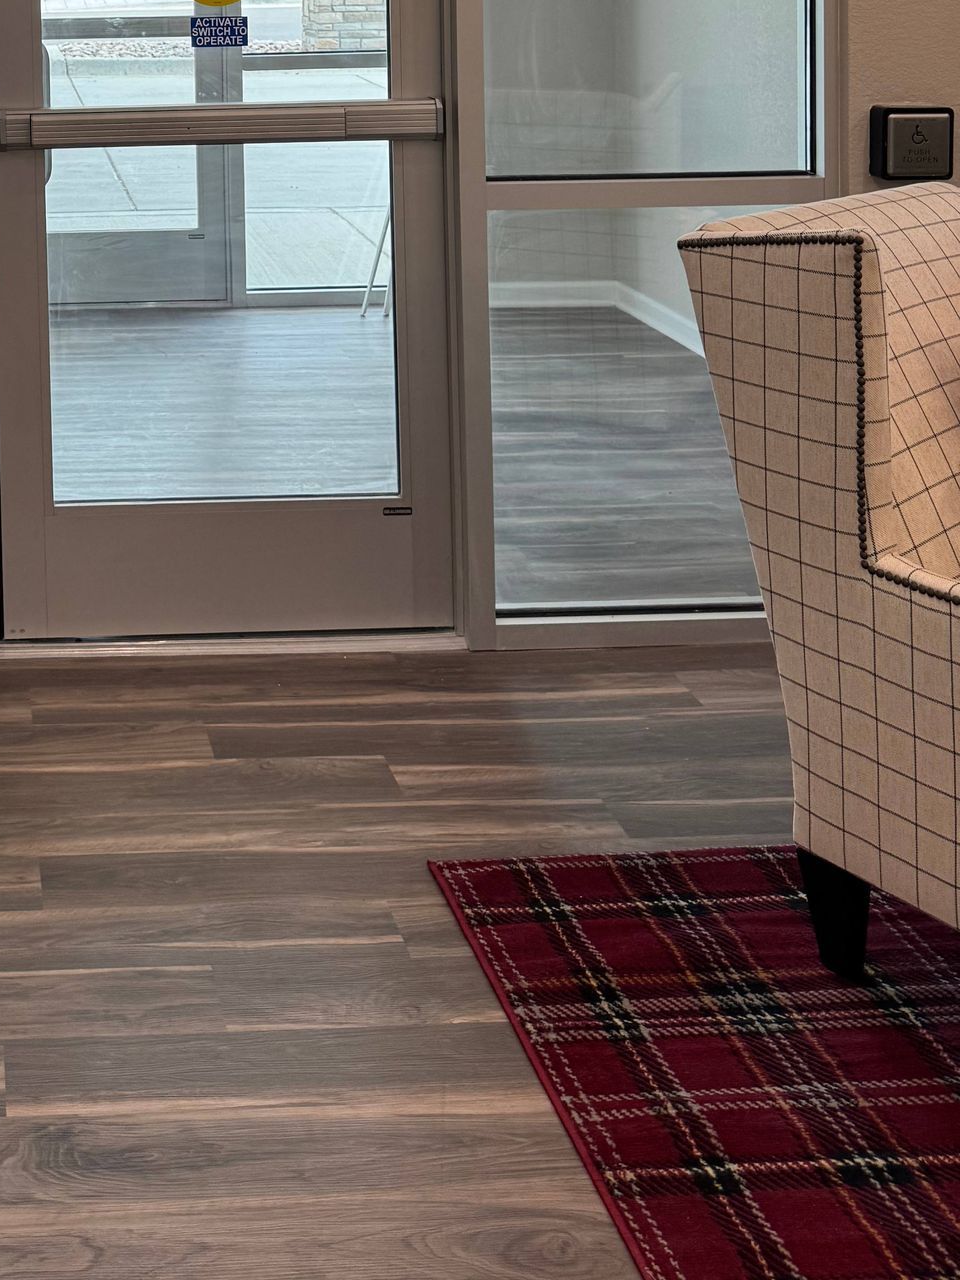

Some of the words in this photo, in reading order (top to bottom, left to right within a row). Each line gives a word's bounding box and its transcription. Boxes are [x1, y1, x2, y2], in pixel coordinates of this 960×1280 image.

[195, 17, 244, 27] ACTIVATE
[191, 26, 231, 36] SWITCH
[235, 26, 247, 36] TO
[196, 36, 244, 46] OPERATE
